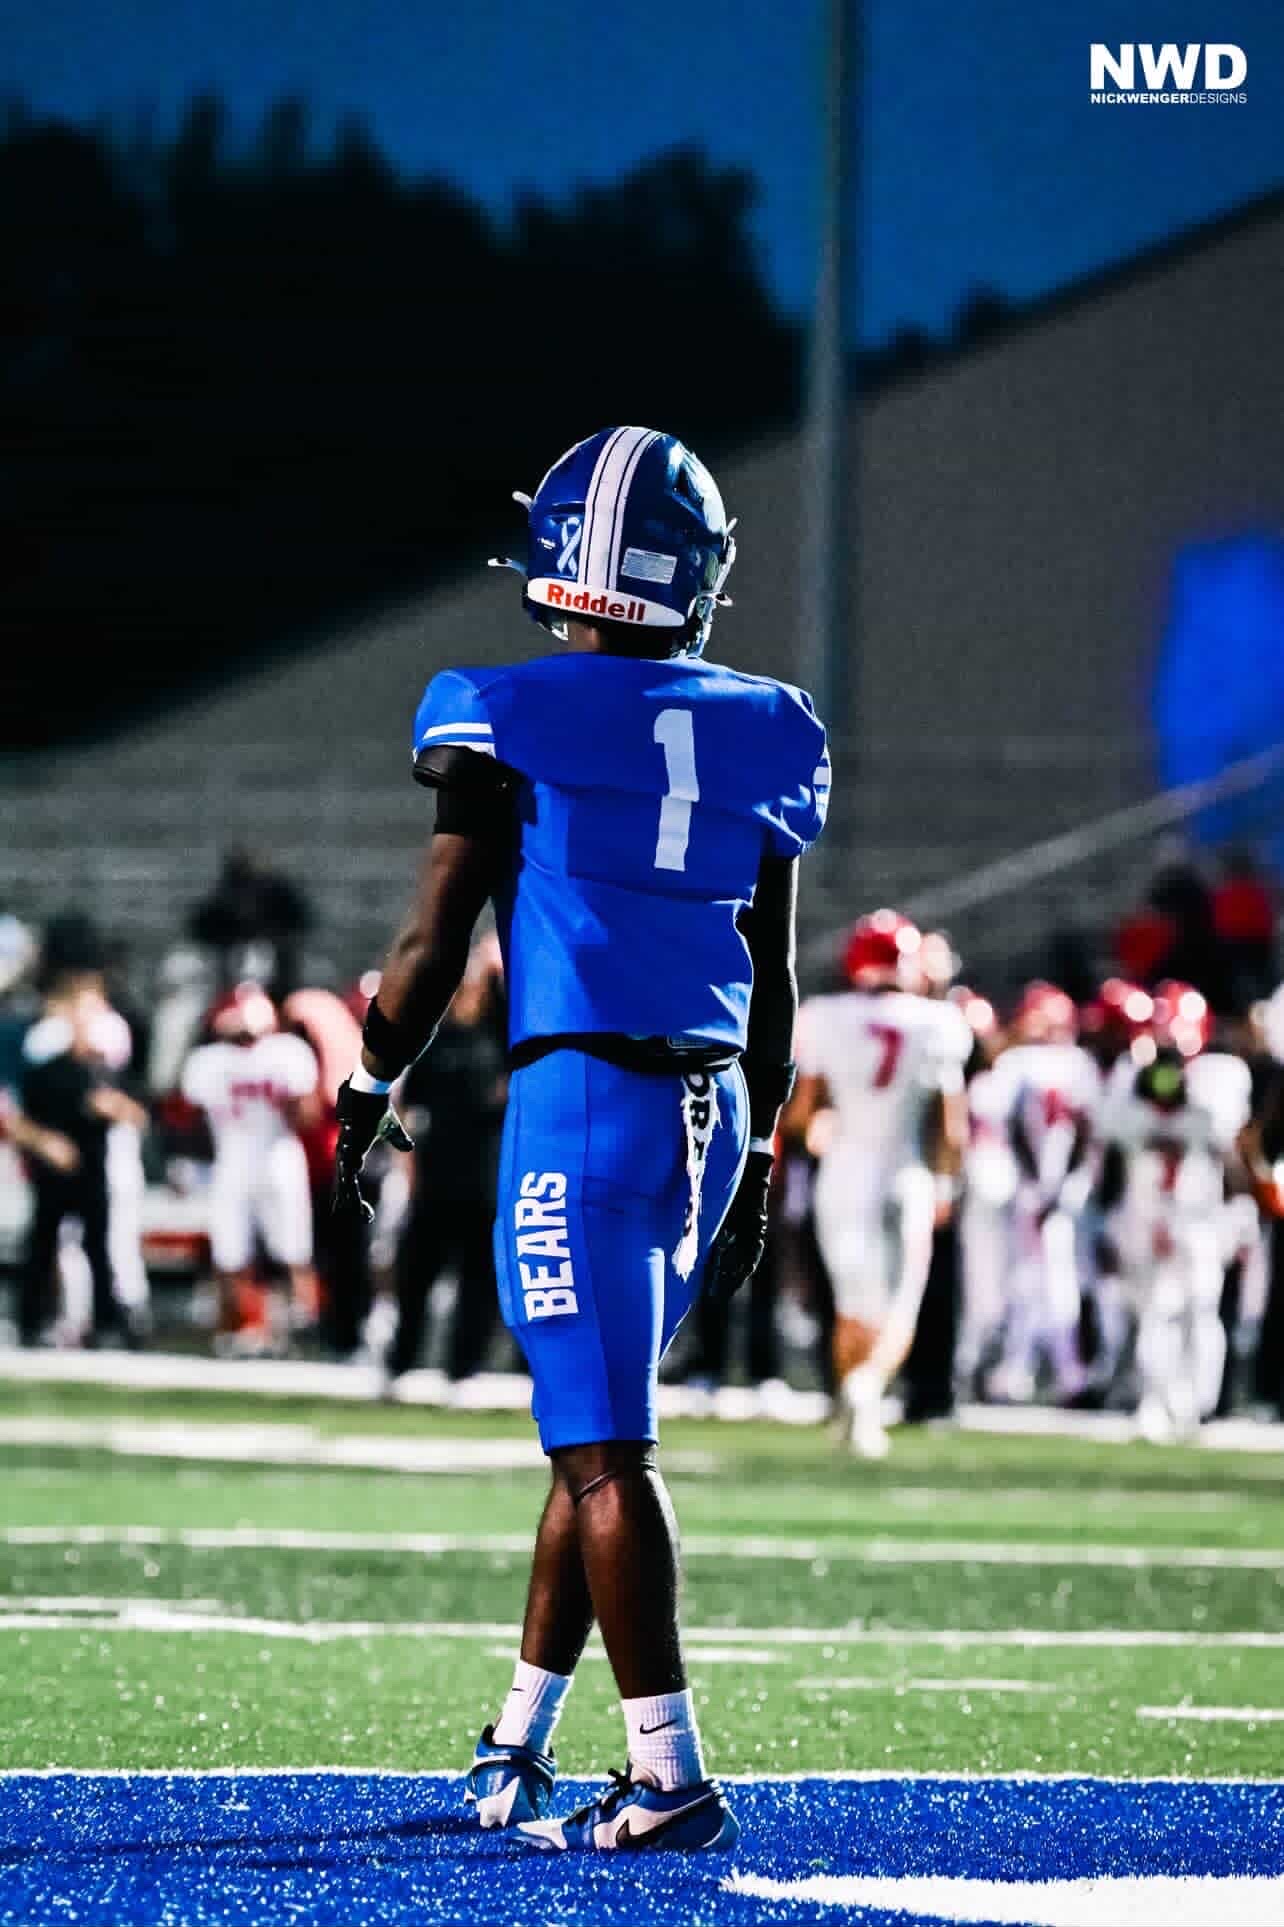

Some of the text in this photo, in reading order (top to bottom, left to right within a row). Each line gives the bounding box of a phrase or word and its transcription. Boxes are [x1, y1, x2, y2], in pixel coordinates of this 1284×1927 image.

[547, 583, 646, 622] Riddell
[653, 708, 700, 872] 1
[866, 1023, 906, 1090] 7
[515, 1171, 579, 1322] BEARS
